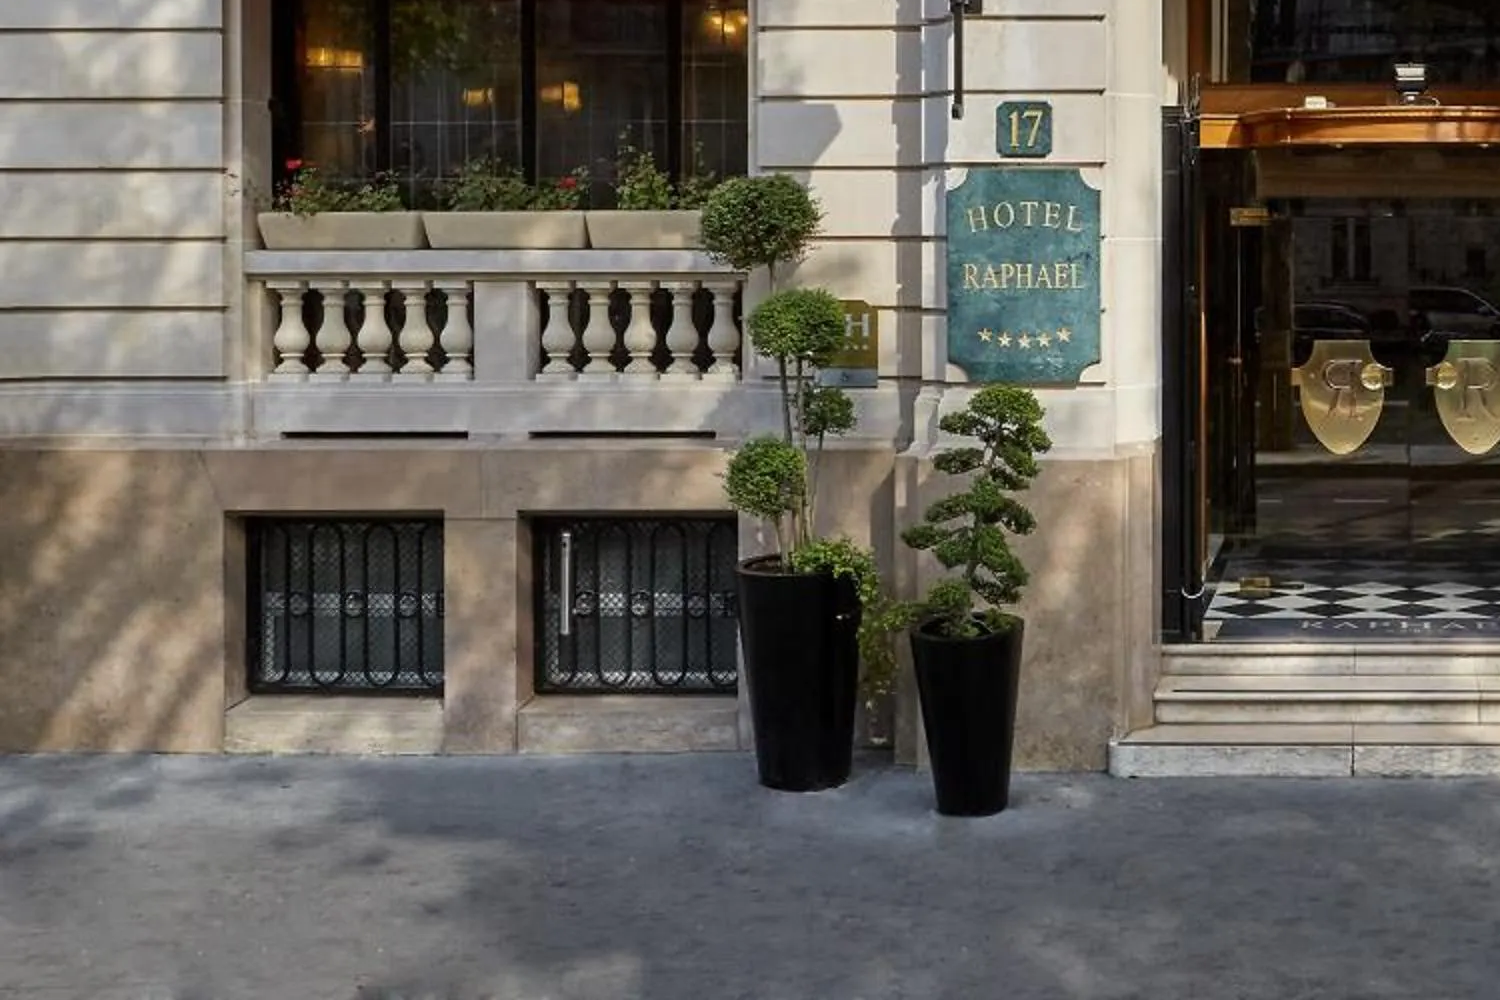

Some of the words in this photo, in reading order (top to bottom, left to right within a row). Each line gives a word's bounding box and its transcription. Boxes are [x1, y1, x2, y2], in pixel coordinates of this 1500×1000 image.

[1008, 108, 1044, 148] 17
[966, 200, 1085, 234] HOTEL
[962, 263, 1086, 290] RAPHAEL
[843, 313, 870, 337] H
